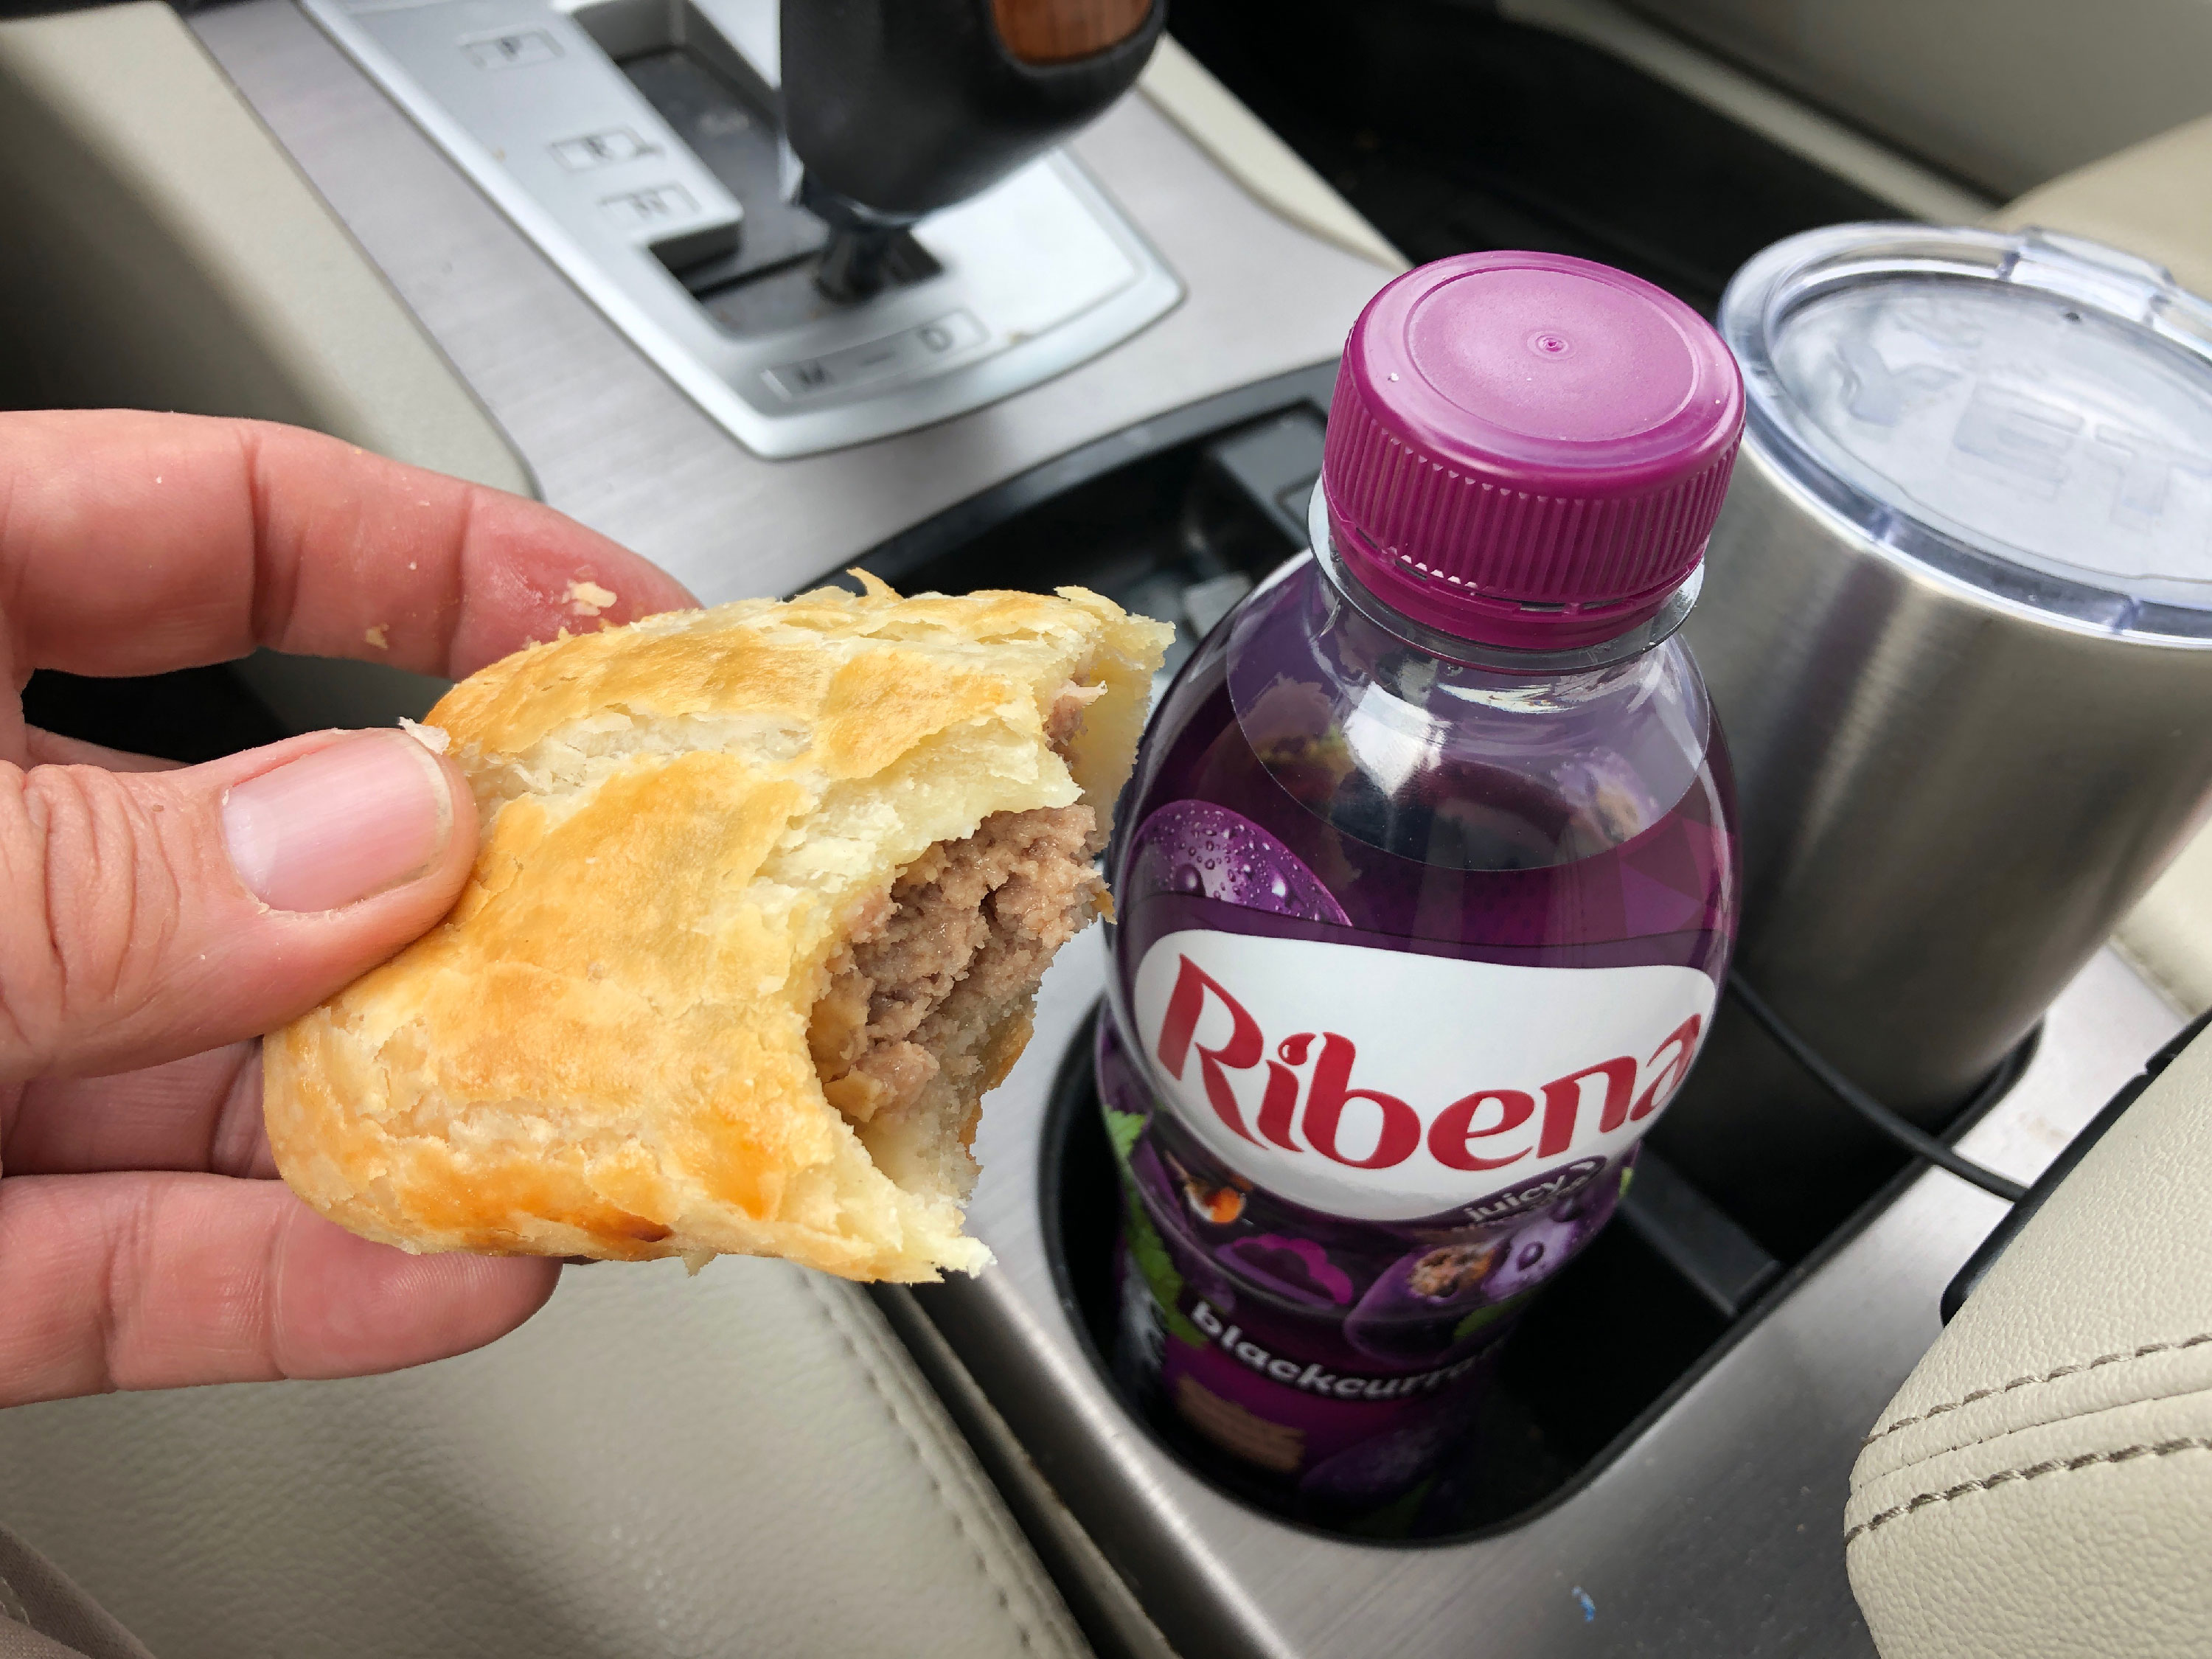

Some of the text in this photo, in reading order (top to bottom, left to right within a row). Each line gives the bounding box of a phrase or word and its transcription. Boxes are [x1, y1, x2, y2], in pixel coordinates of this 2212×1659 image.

[1836, 317, 2212, 537] YET
[1157, 953, 1702, 1172] Ribena
[1462, 1174, 1567, 1222] juicy
